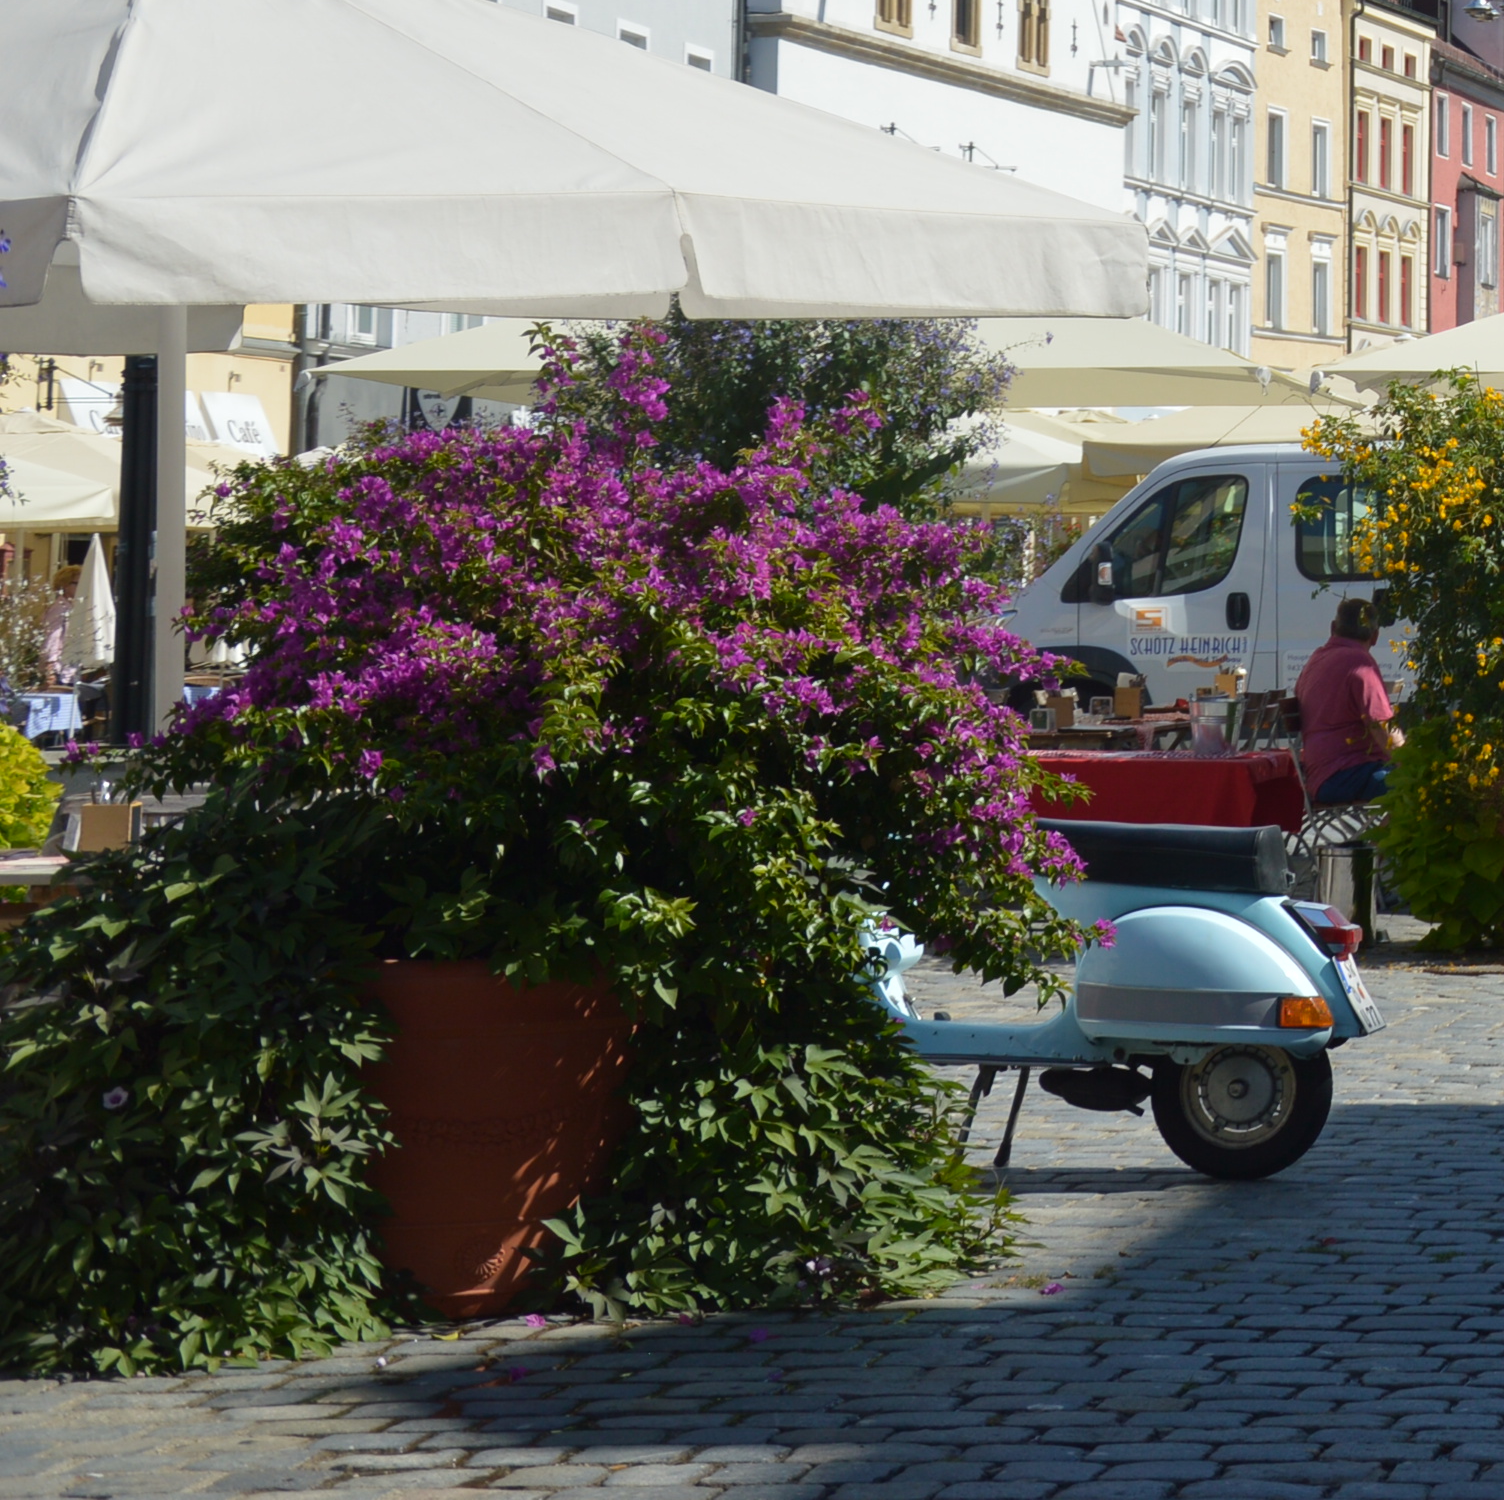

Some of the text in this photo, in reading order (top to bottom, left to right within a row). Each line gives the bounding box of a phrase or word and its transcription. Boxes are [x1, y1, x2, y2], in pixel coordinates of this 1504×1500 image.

[227, 419, 262, 444] Café
[1130, 634, 1175, 656] SCHÖTZ
[1179, 636, 1241, 654] HEINRICH
